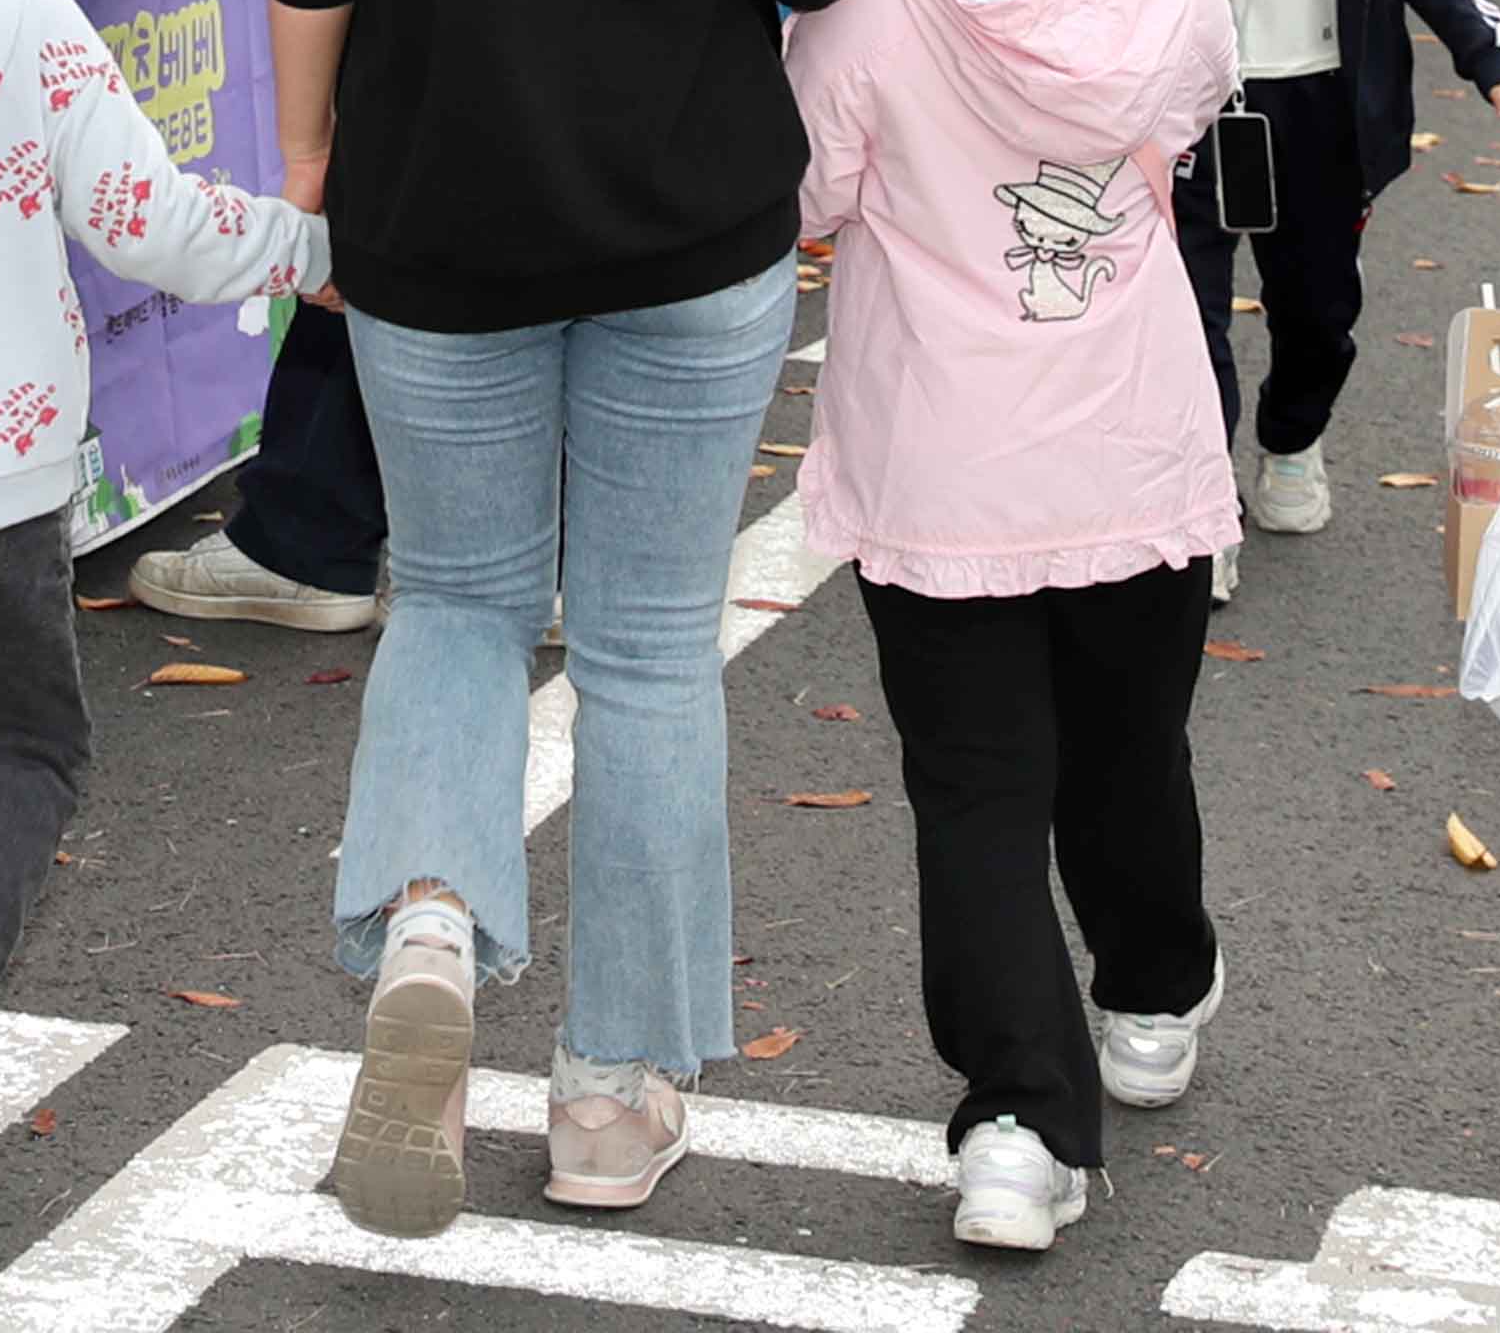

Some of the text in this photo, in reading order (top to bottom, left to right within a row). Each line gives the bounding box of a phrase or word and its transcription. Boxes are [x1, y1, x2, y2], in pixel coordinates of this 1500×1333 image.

[107, 11, 218, 103] 츠베베
[88, 171, 112, 229] Alain
[106, 161, 132, 247] Martine
